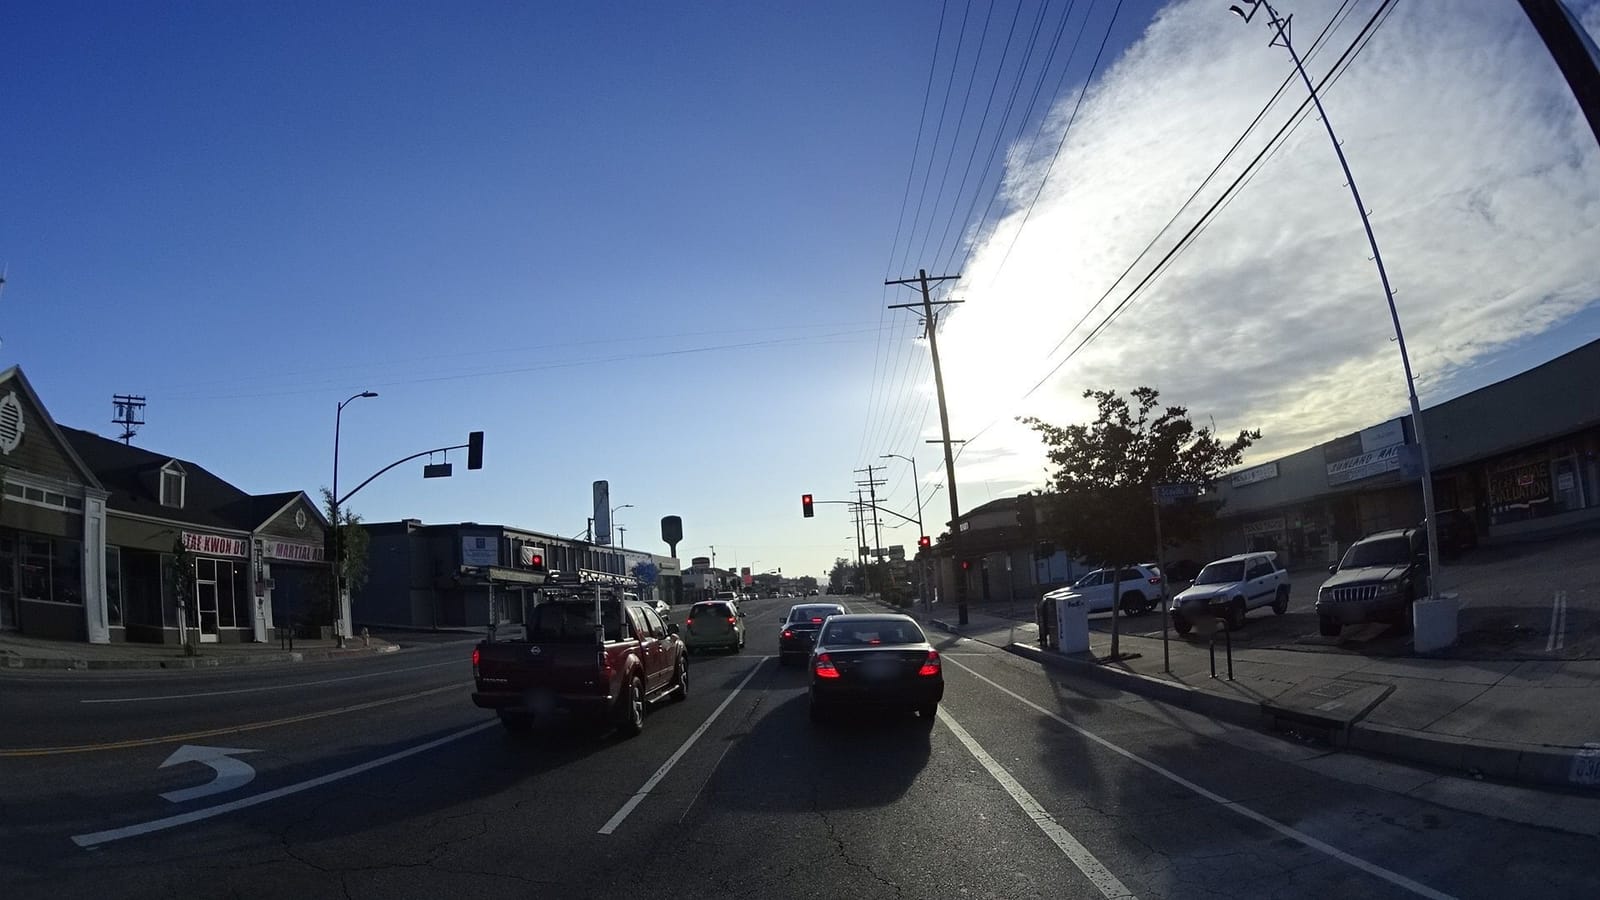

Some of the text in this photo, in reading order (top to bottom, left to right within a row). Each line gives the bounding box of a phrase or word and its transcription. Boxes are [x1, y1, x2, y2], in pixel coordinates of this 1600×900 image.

[1331, 454, 1373, 472] SUNLAND
[185, 534, 247, 556] TAE KWON DO
[276, 543, 311, 560] MARTIAL
